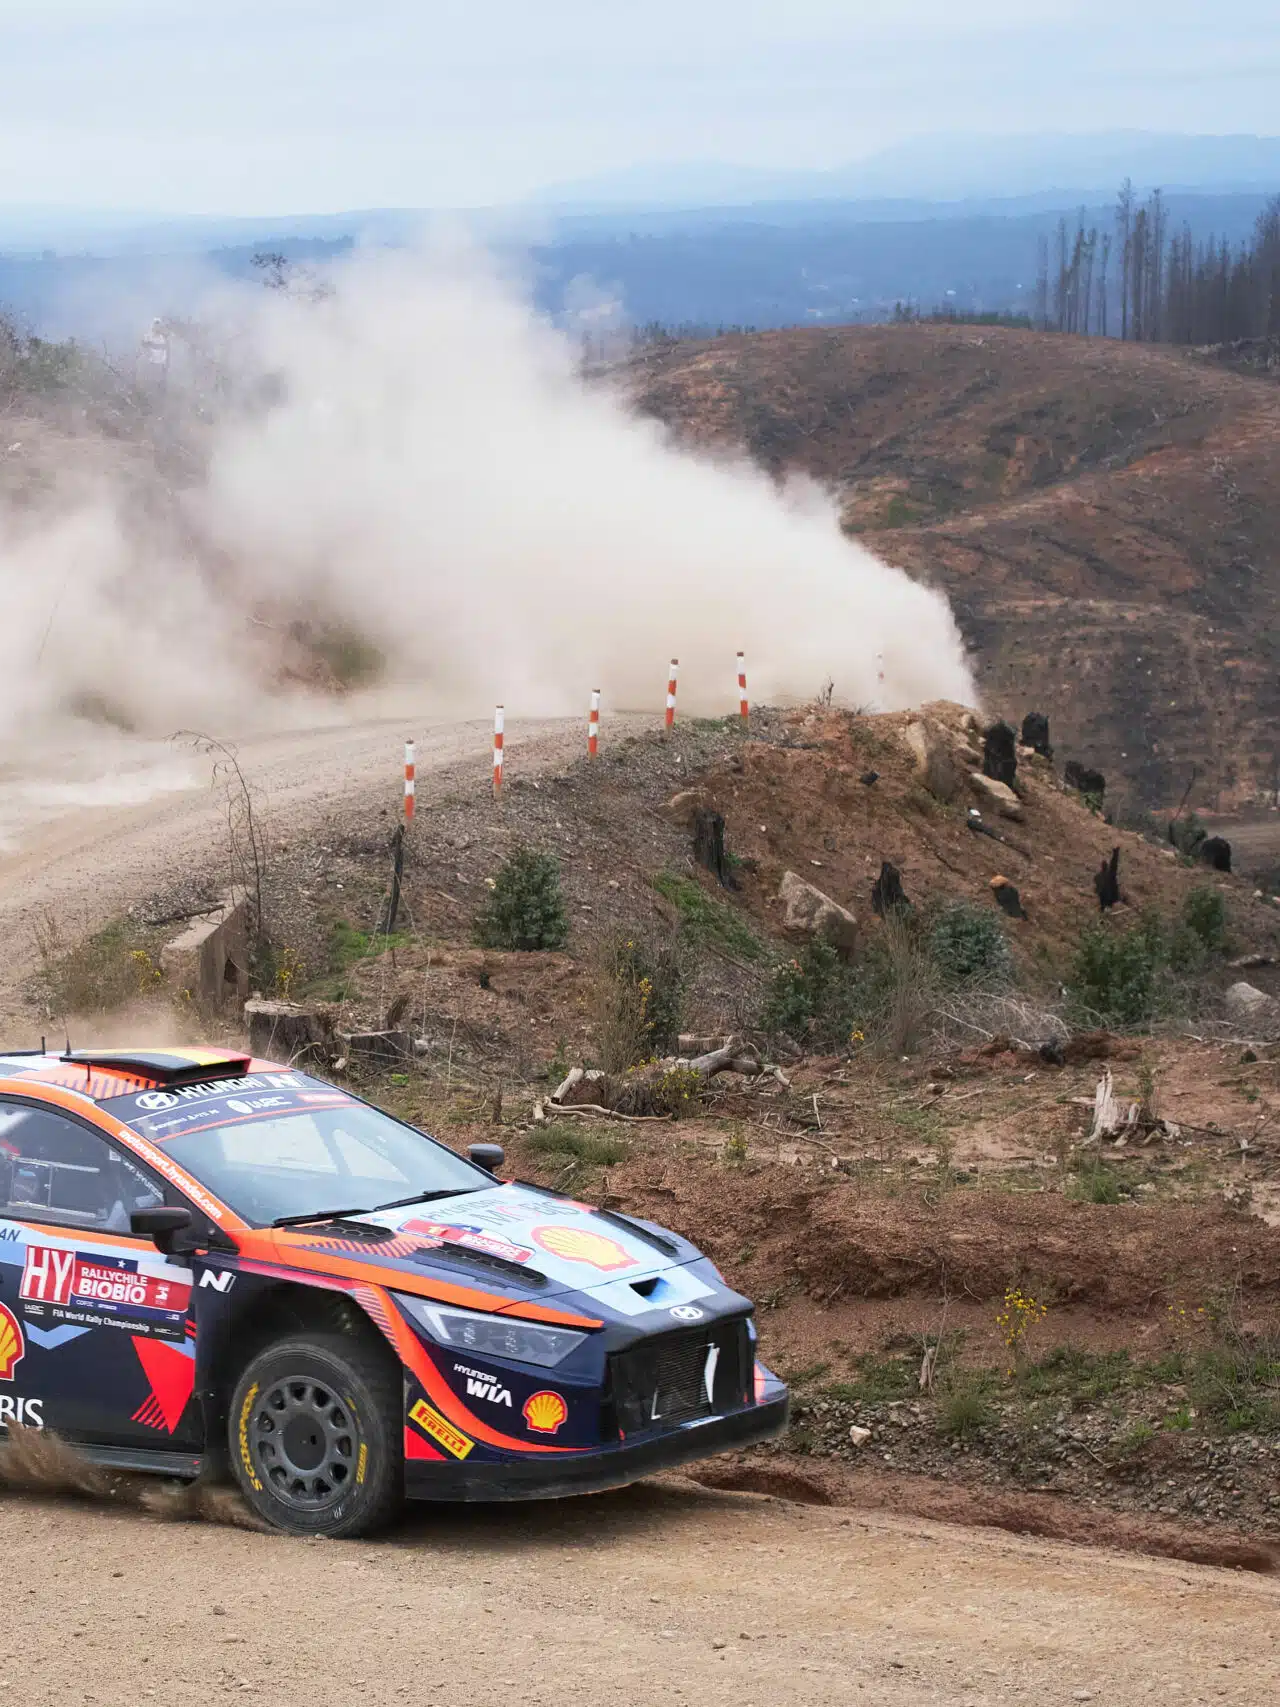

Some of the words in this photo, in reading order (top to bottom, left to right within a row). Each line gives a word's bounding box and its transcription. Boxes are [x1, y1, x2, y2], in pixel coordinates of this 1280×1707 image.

[175, 1077, 266, 1099] HYUNDAI
[119, 1129, 223, 1219] motorsport.hyundai.com
[23, 1247, 74, 1301] HY
[52, 1308, 65, 1318] FIA
[65, 1311, 85, 1322] World
[85, 1313, 104, 1326] Rally
[103, 1317, 151, 1334] Championship
[453, 1363, 498, 1383] HYUNDAI
[466, 1378, 513, 1408] WIA
[416, 1406, 467, 1453] PIRELLI
